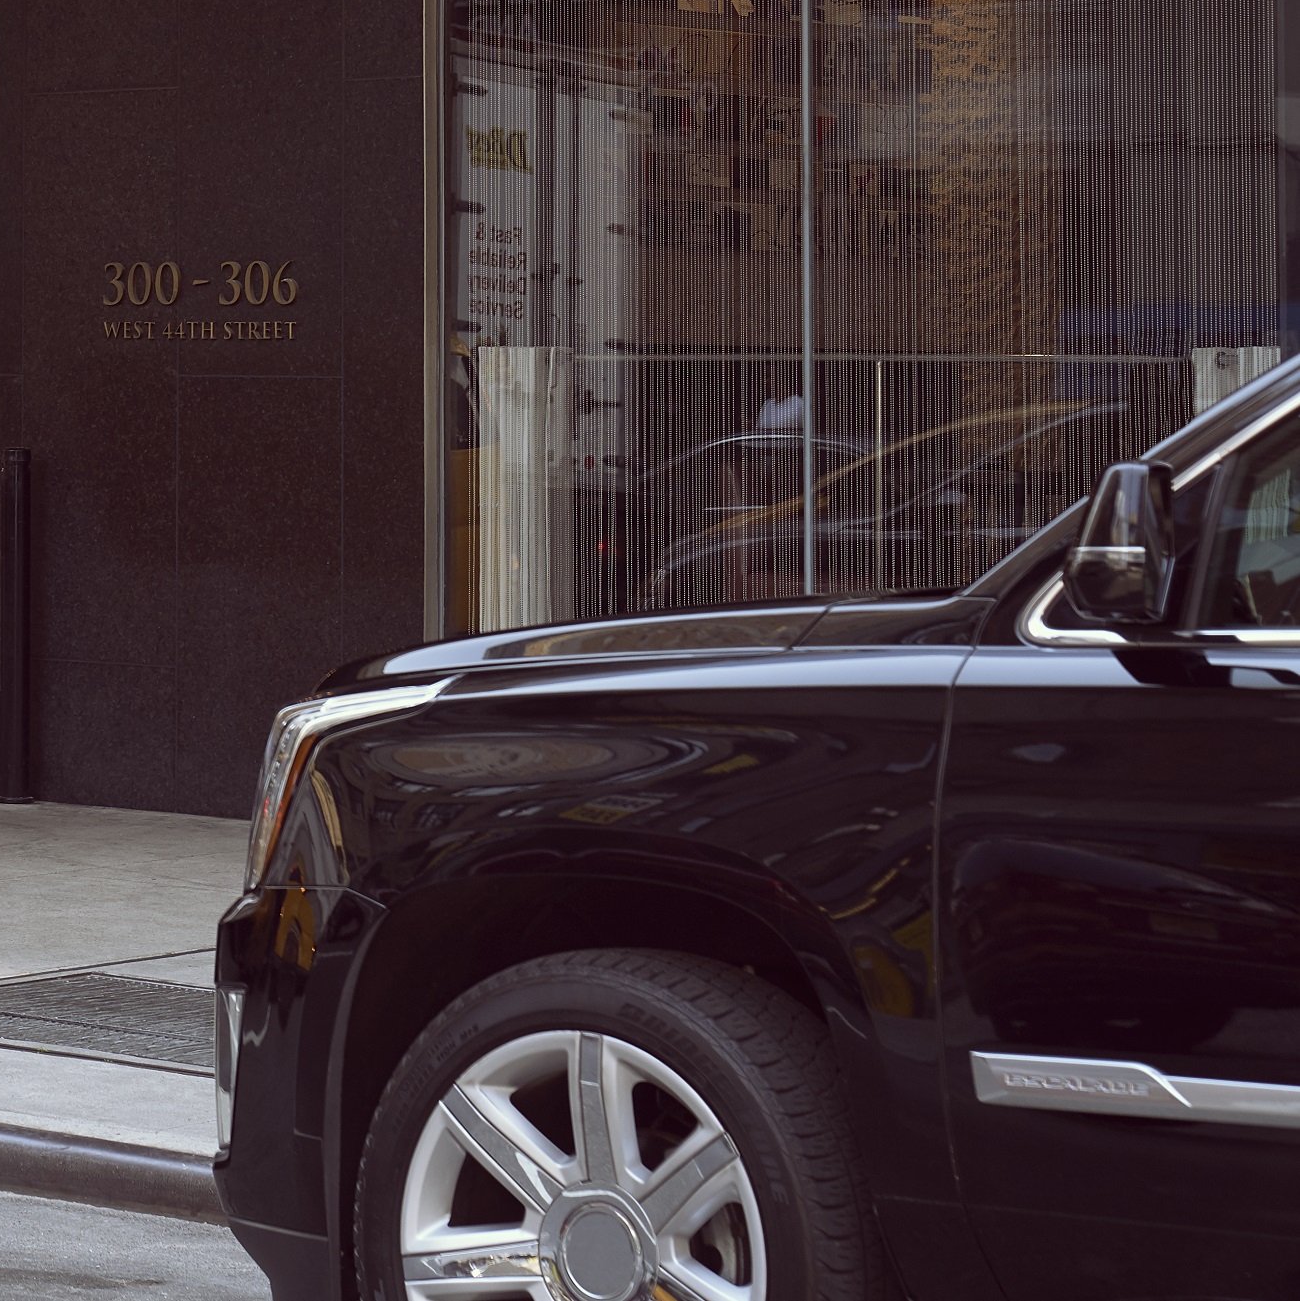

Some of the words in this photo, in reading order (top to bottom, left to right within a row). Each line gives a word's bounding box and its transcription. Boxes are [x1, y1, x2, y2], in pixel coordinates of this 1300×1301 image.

[102, 261, 181, 306] 300
[218, 260, 298, 306] 306
[103, 321, 156, 340] WEST
[162, 321, 217, 340] 44TH
[223, 321, 297, 340] STREET
[1003, 1071, 1150, 1097] ESCALADE
